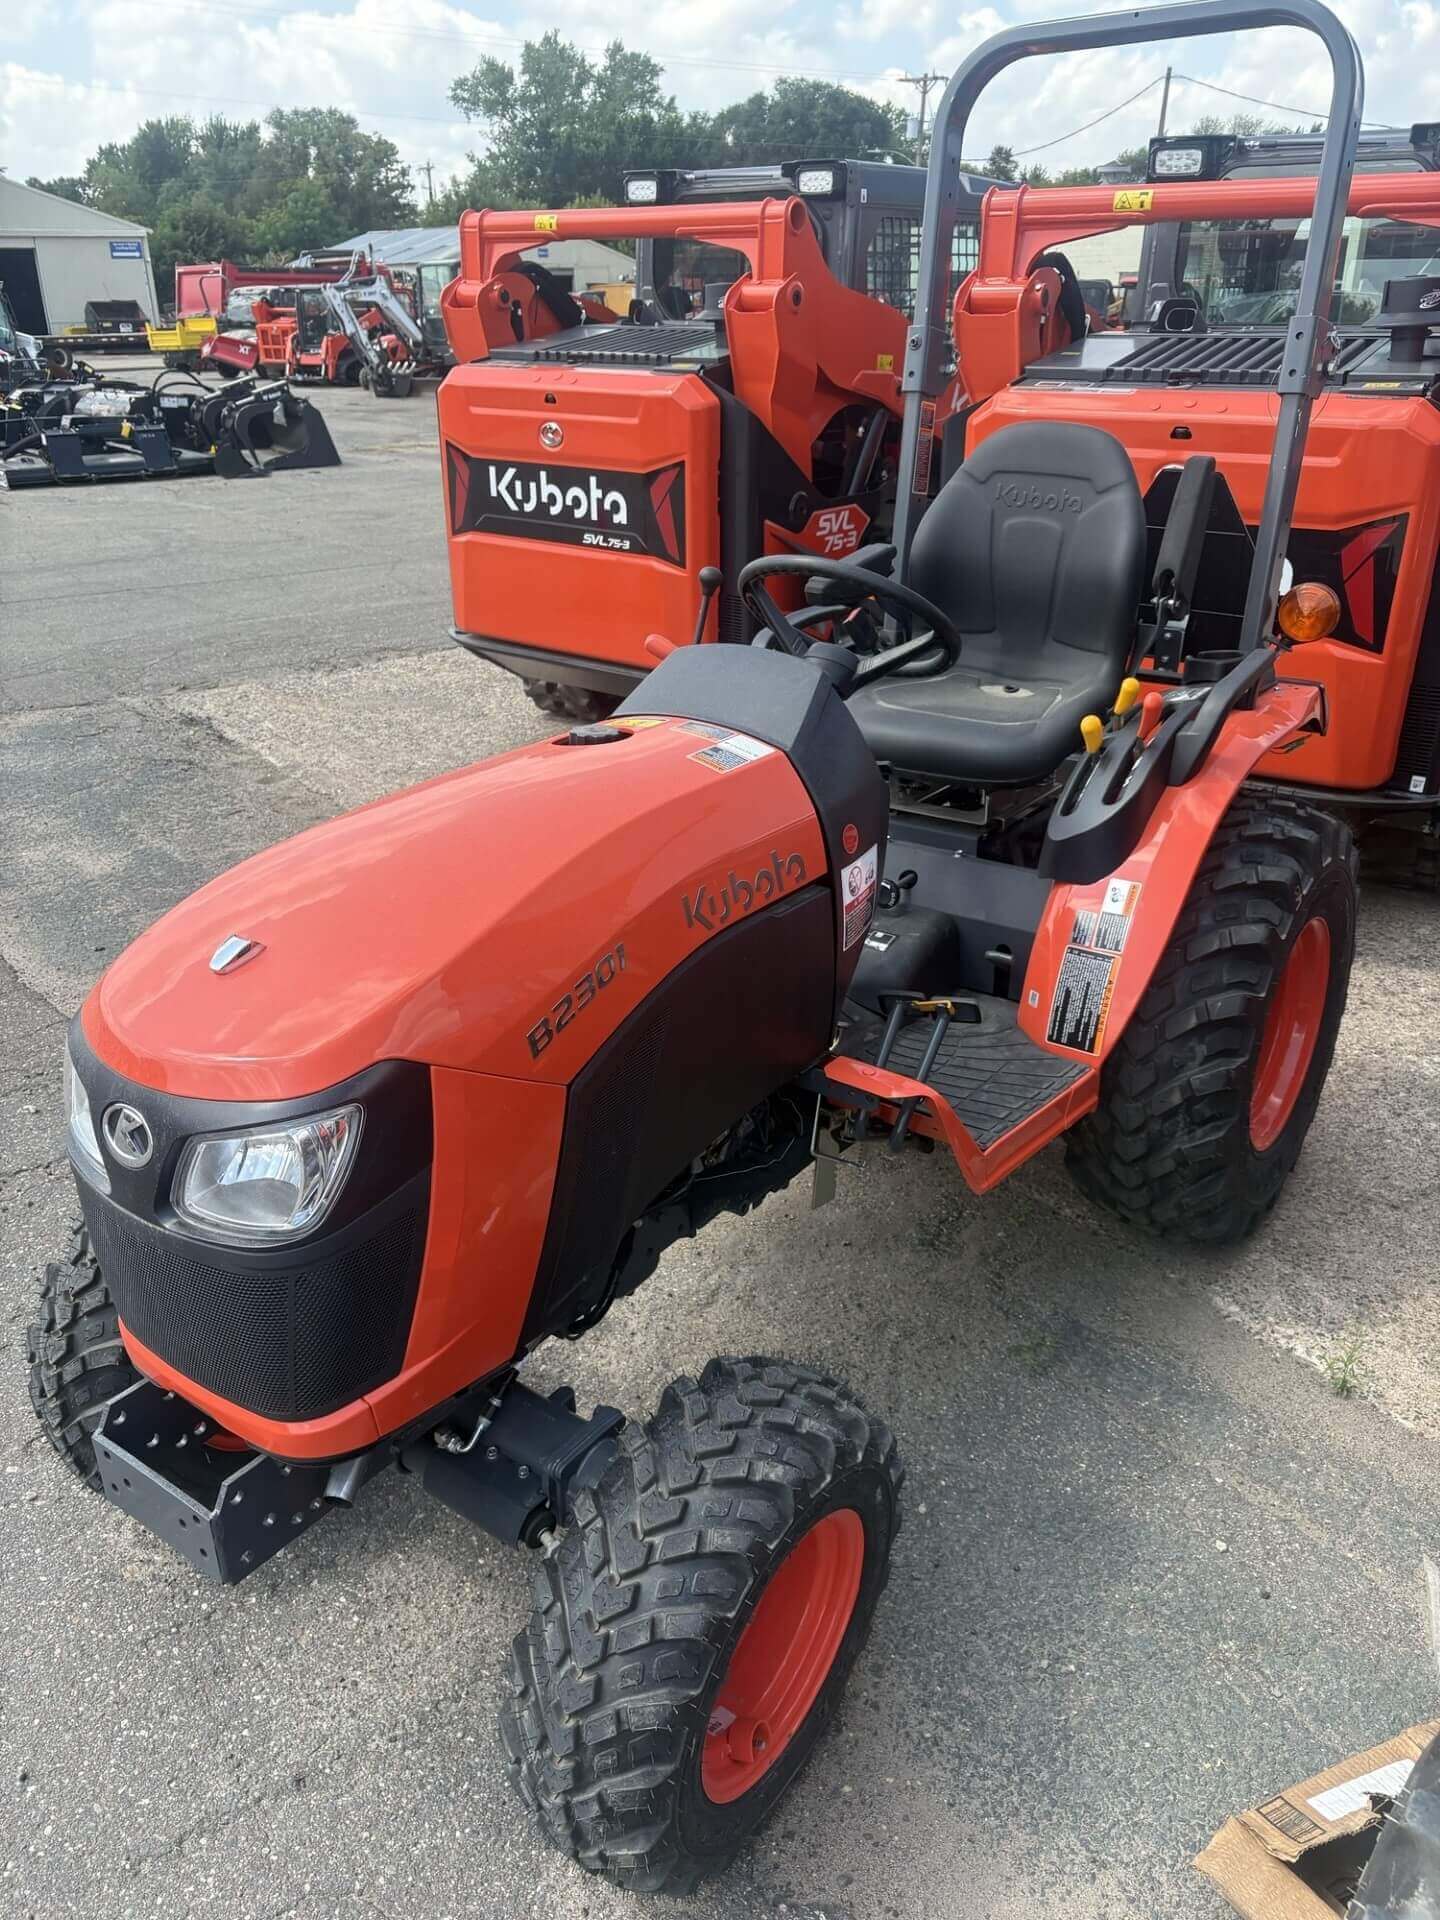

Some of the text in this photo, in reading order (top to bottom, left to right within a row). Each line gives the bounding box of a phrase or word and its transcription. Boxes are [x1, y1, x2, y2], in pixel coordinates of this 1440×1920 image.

[488, 465, 627, 525] Kubota
[995, 483, 1083, 513] Kubota
[816, 510, 855, 536] SVL
[824, 531, 857, 553] 75-3
[681, 849, 806, 930] Kubota
[526, 942, 625, 1059] B2301
